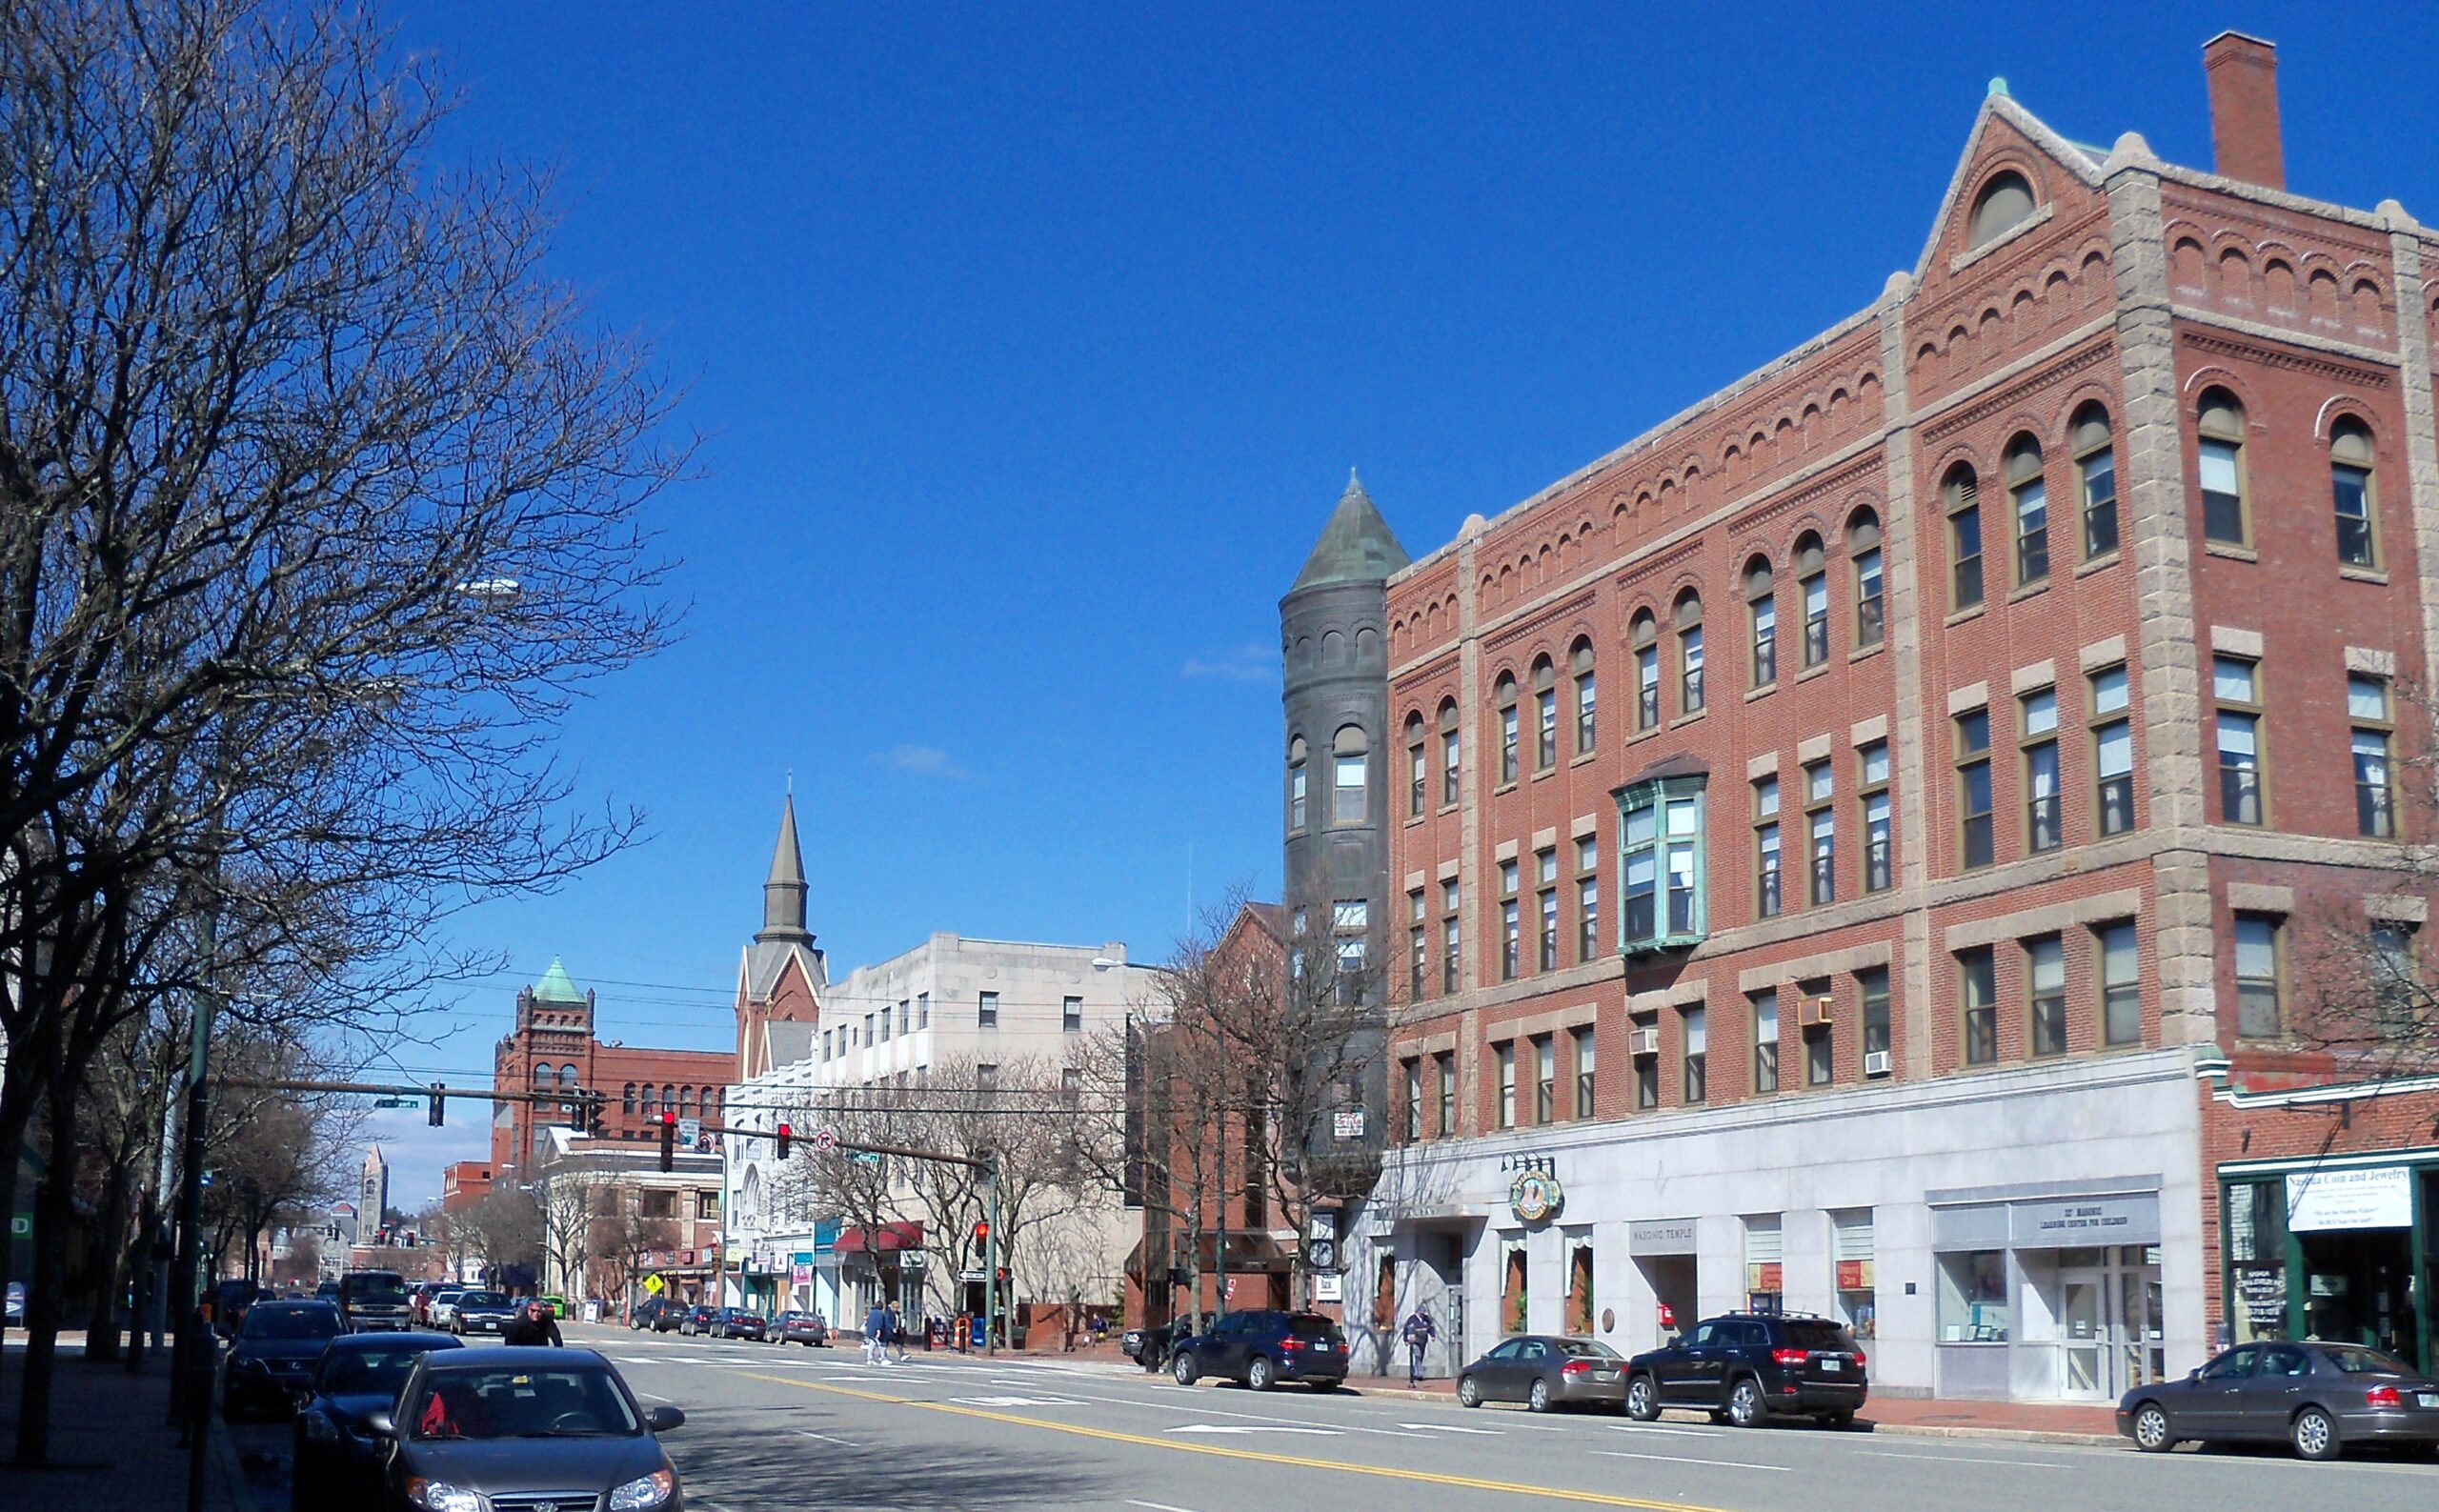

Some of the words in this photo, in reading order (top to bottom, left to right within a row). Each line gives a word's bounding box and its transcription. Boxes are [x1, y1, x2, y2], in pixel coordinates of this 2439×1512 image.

[2324, 1173, 2347, 1184] Coin
[2348, 1171, 2367, 1182] and
[2368, 1169, 2409, 1182] Jewelry
[1665, 1227, 1693, 1240] TEMPLE
